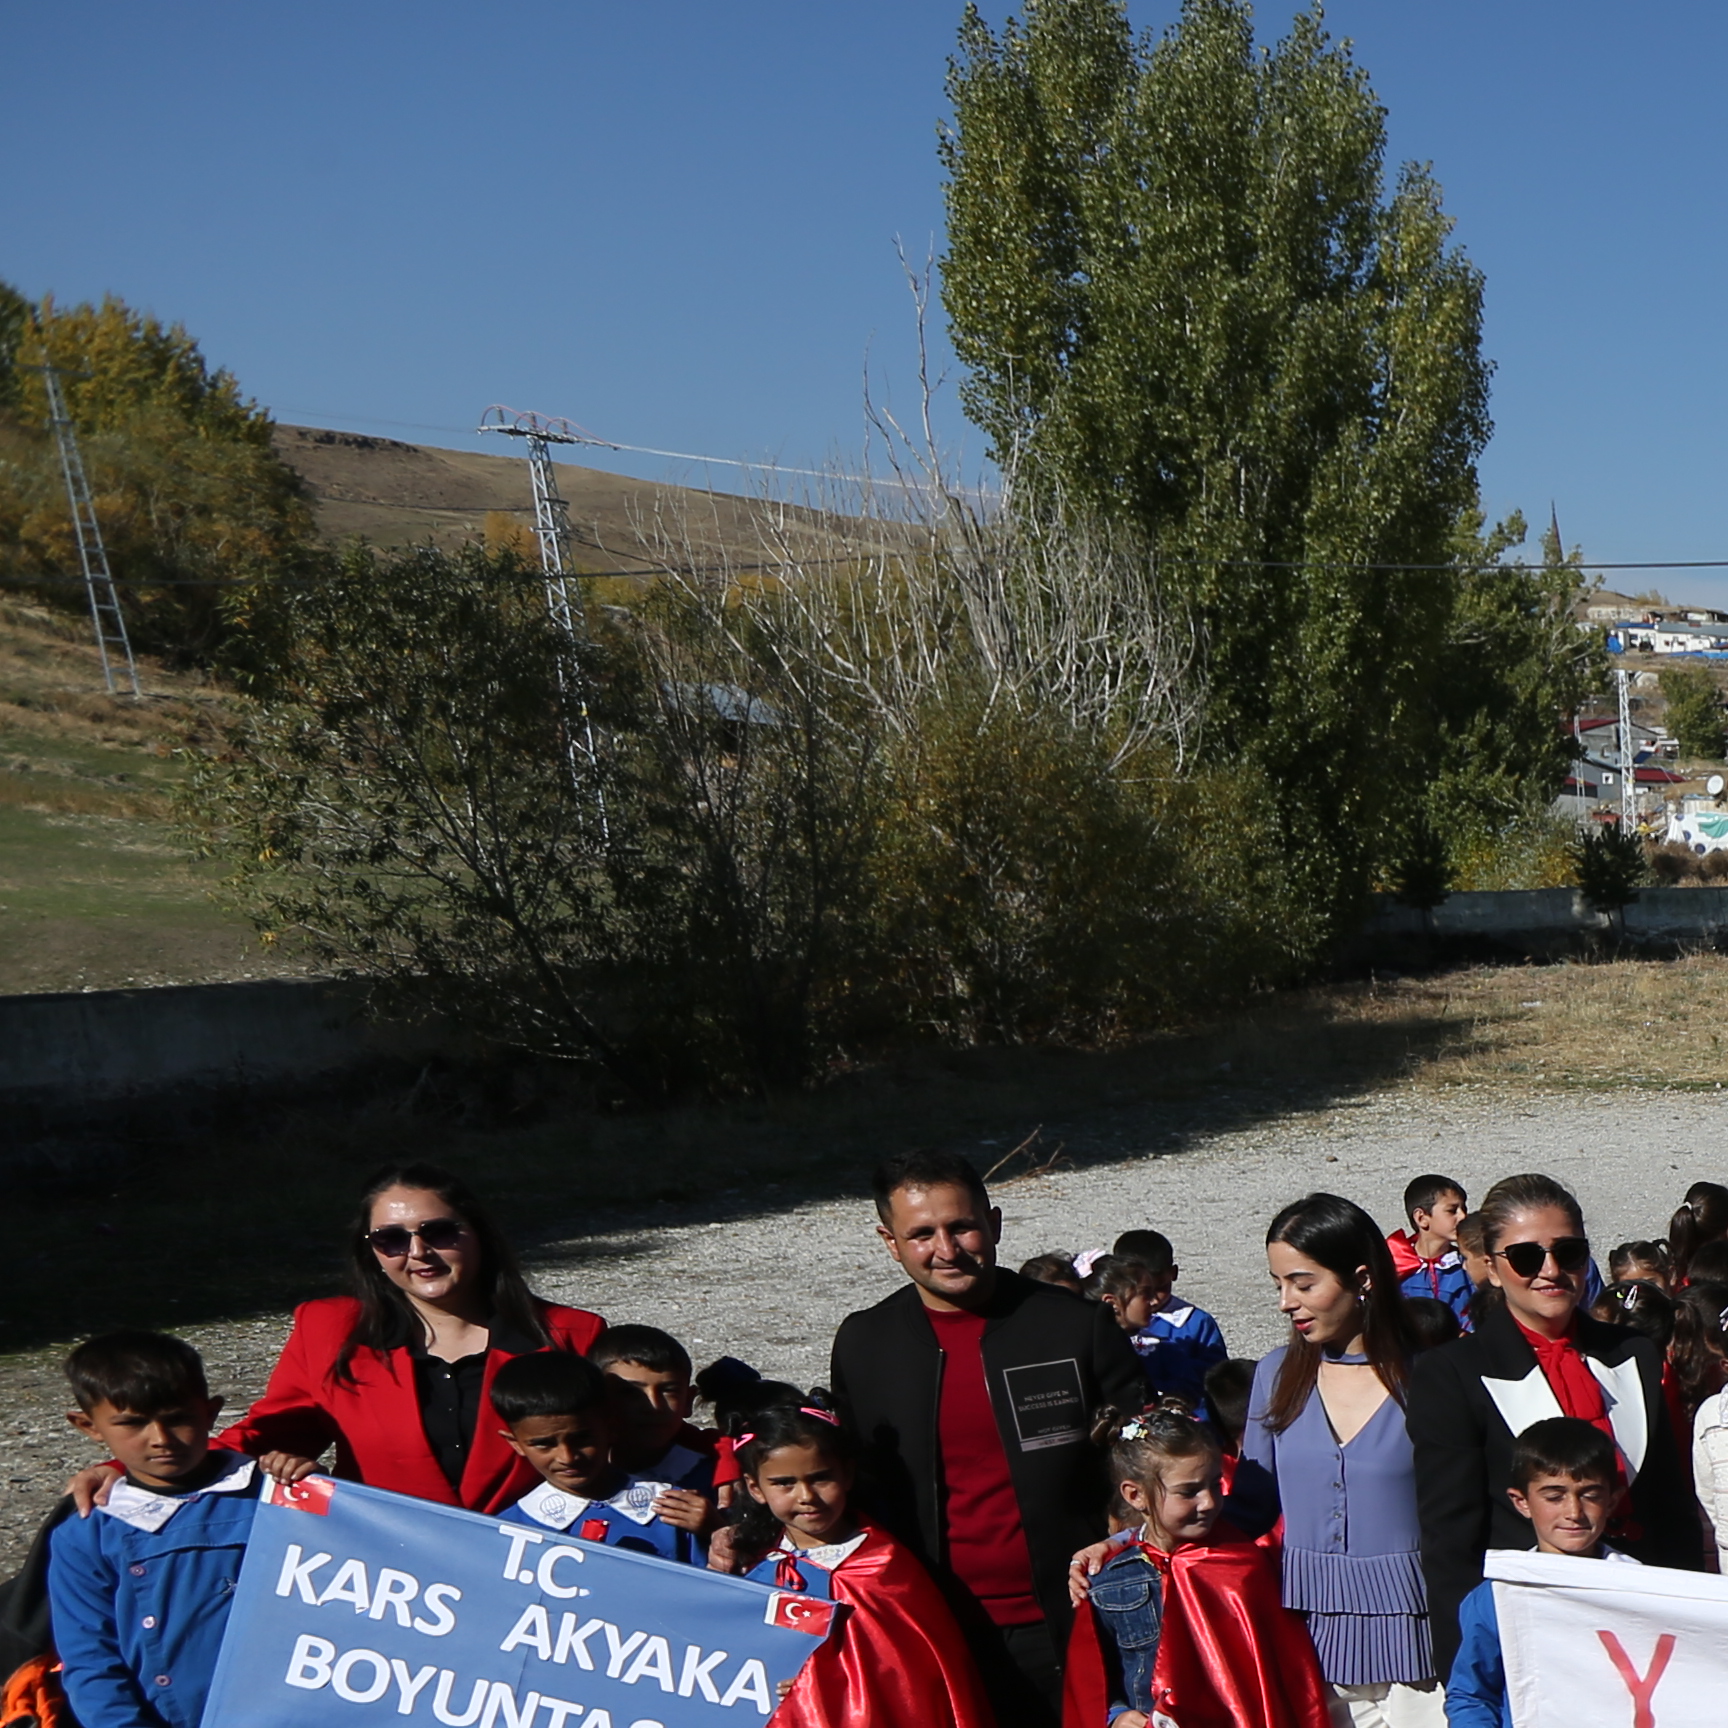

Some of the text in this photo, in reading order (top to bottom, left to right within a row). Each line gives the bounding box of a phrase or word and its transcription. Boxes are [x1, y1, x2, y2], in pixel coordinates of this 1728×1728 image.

[498, 1524, 590, 1599] T.C.
[275, 1544, 772, 1715] KARS AKYAKA
